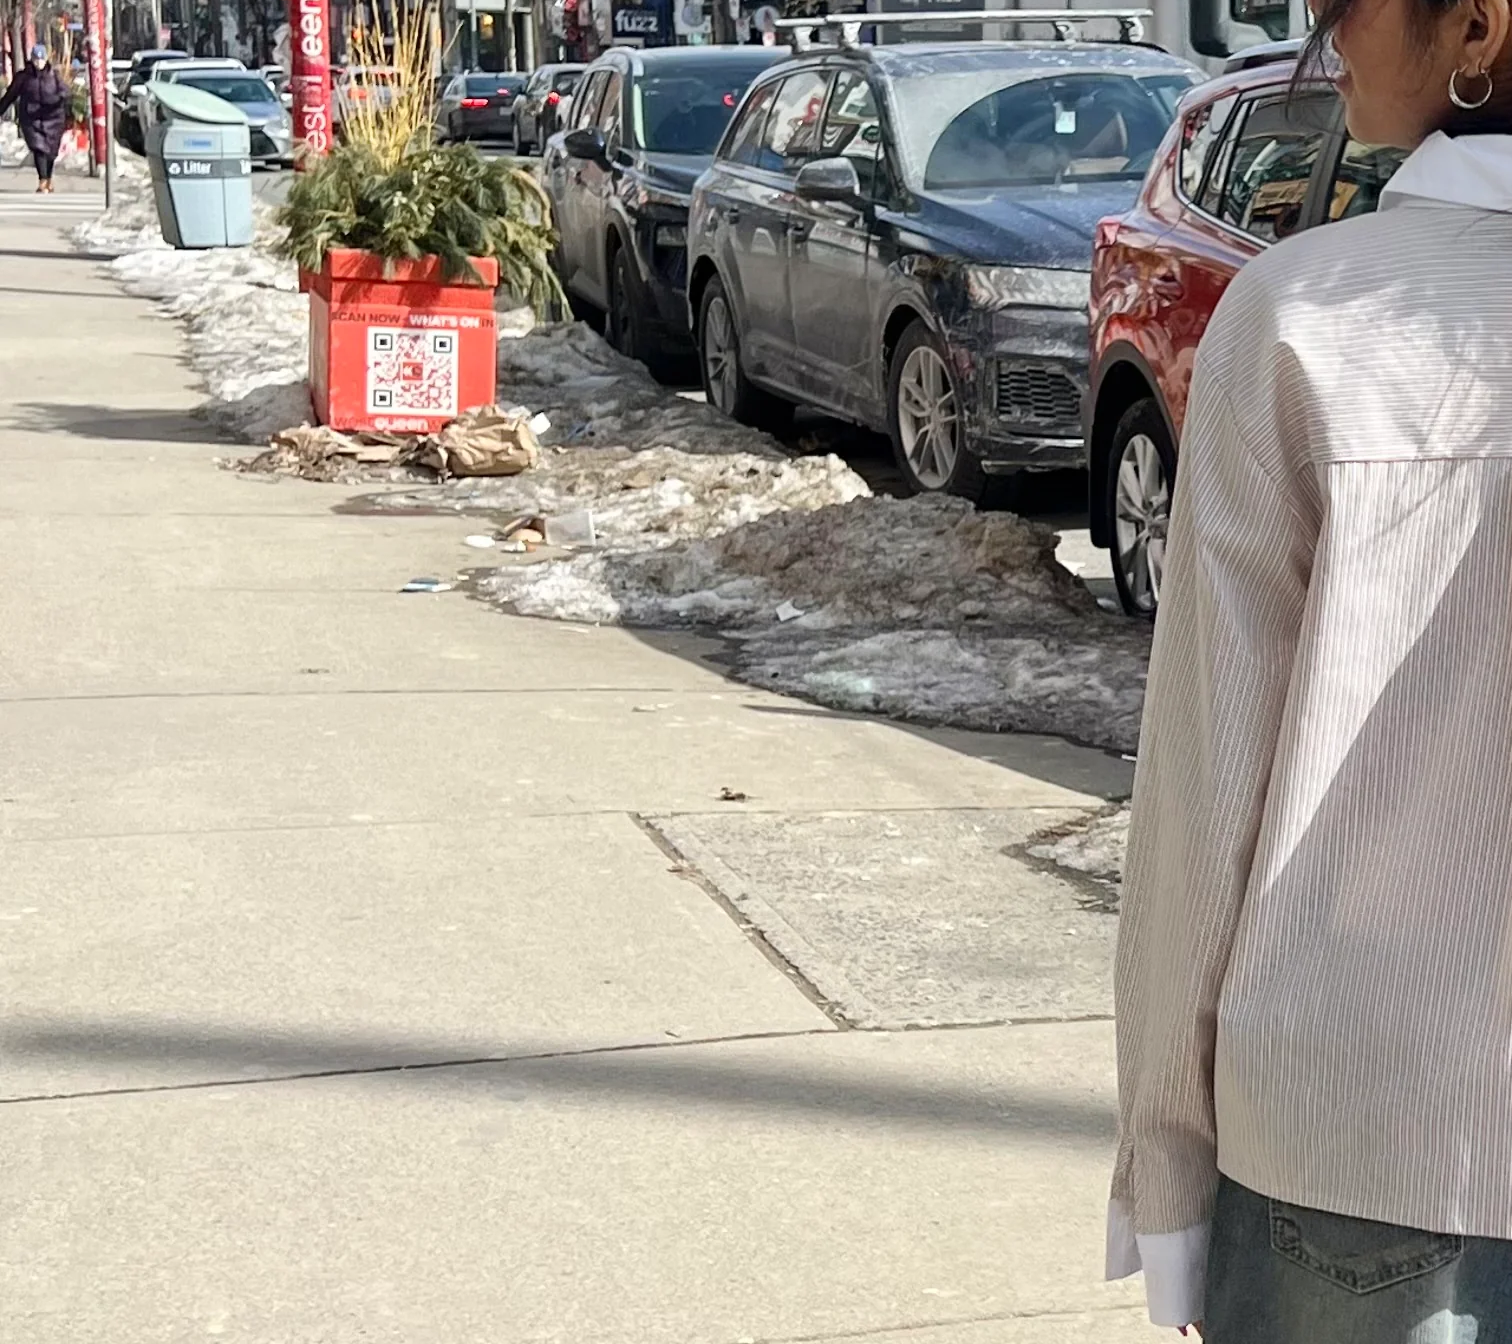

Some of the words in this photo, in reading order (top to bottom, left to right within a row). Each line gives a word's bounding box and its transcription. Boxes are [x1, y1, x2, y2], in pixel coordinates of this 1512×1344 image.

[183, 160, 211, 175] Litter
[369, 313, 401, 324] NOW
[460, 316, 480, 328] ON
